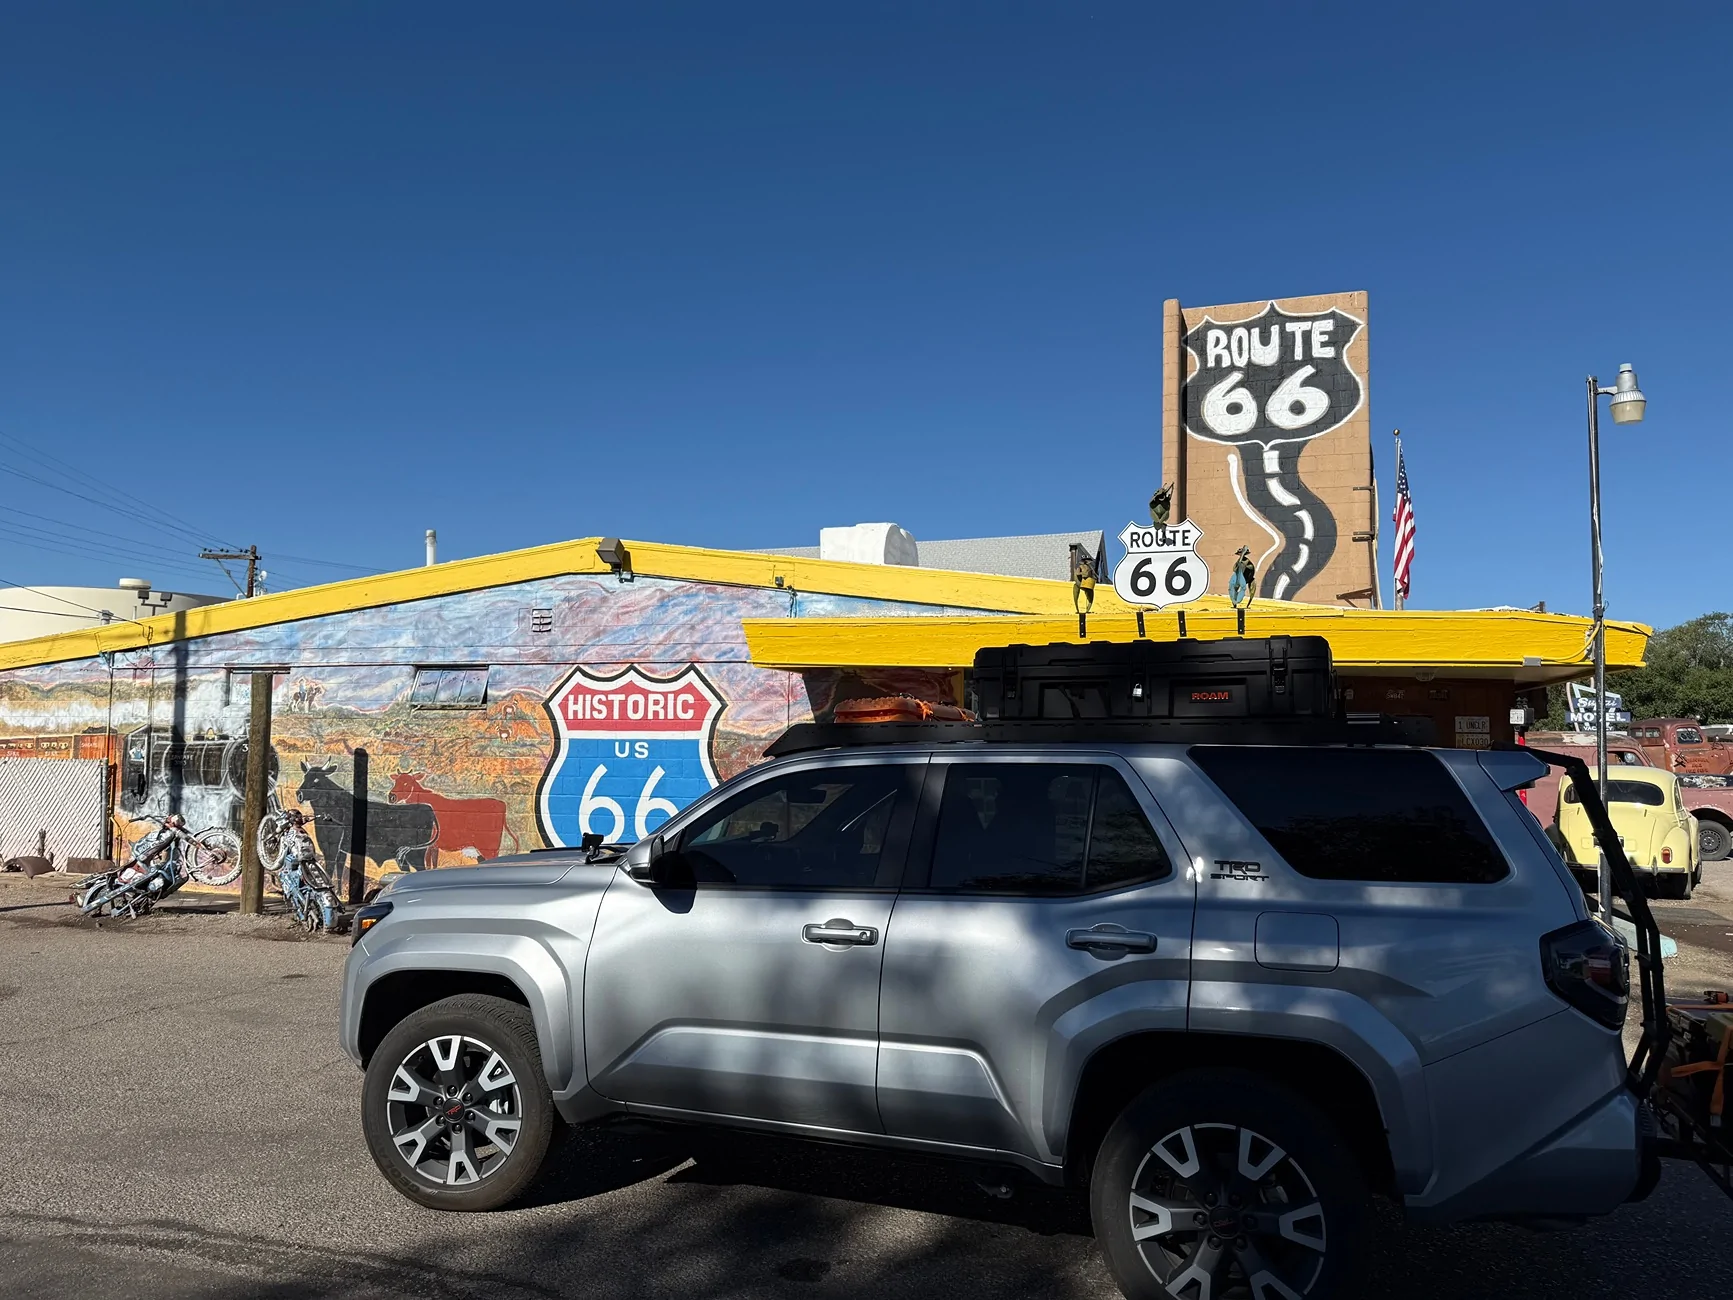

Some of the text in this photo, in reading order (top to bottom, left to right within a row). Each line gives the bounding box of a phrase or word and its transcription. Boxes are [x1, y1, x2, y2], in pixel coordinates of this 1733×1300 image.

[1206, 319, 1335, 368] ROUTE
[1202, 365, 1330, 435] 66
[1130, 529, 1191, 548] ROUTE
[1130, 556, 1192, 597] 66
[1191, 691, 1229, 700] ROAM
[567, 693, 695, 720] HISTORIC
[1570, 712, 1626, 722] MOEL
[614, 741, 649, 758] US
[579, 764, 680, 843] 66
[1214, 860, 1261, 874] TRD
[1210, 873, 1270, 881] SPORT
[446, 1104, 461, 1115] TRD
